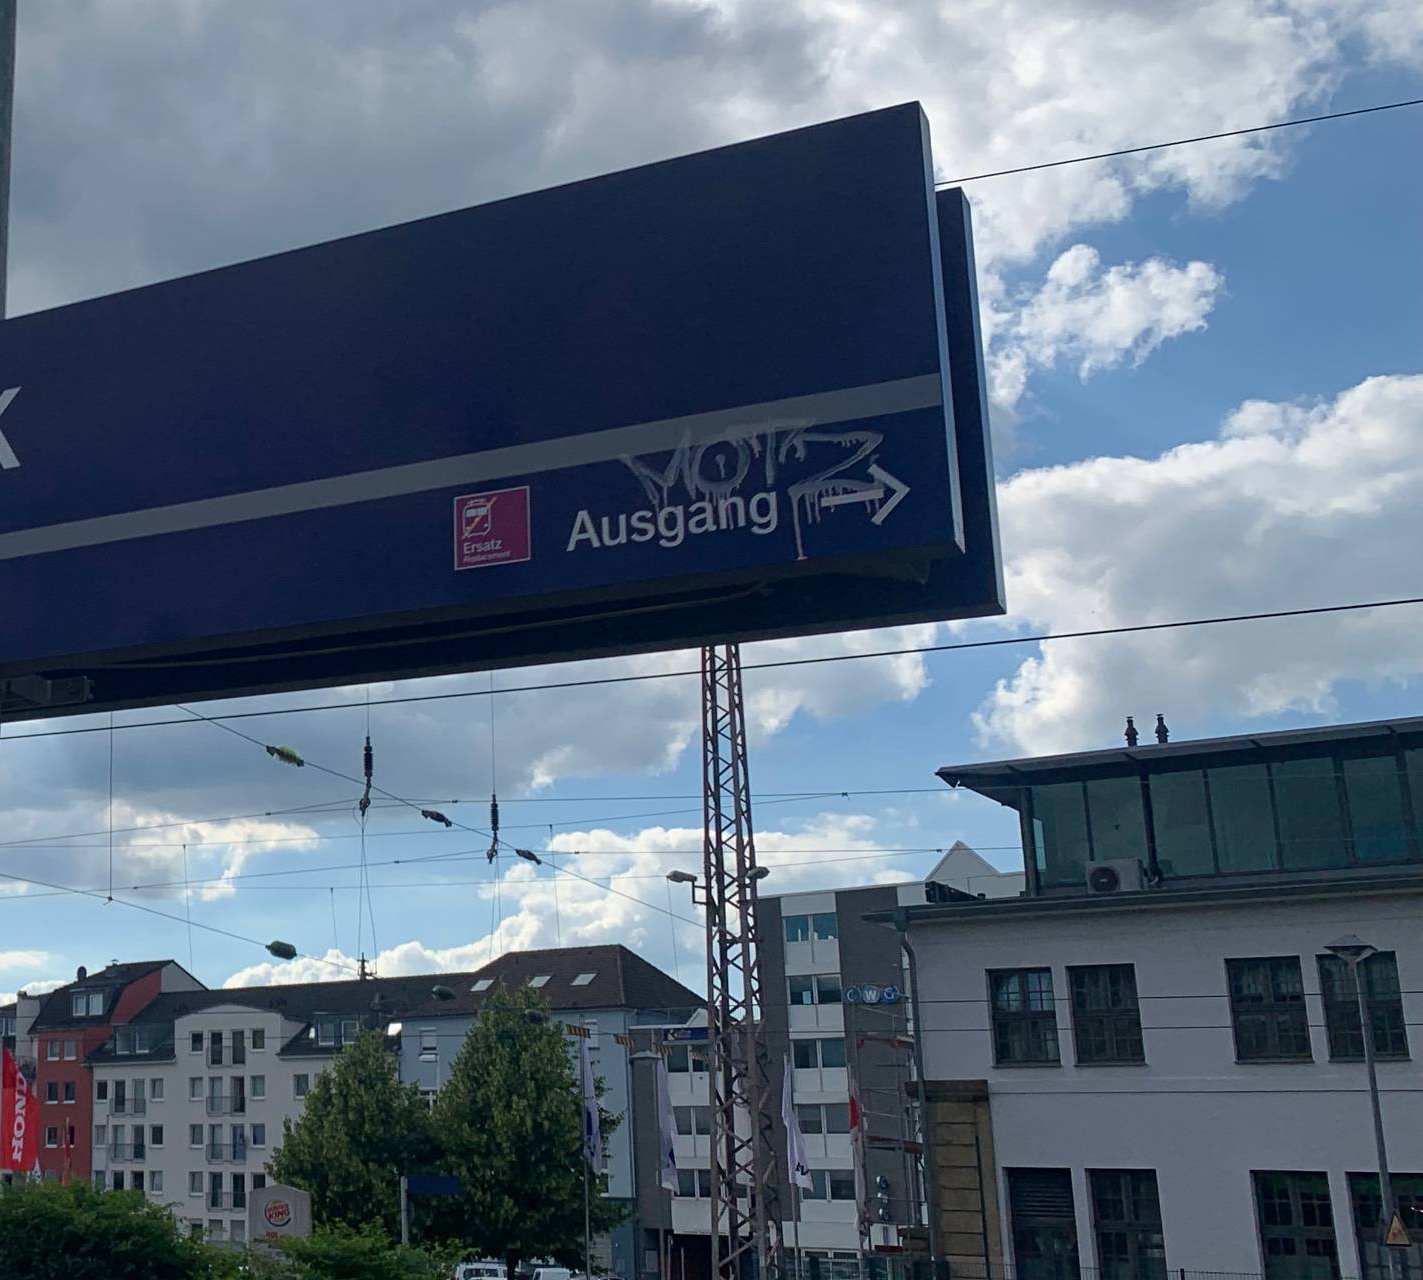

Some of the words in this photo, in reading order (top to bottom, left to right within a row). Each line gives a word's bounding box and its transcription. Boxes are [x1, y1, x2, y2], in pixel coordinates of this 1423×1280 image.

[463, 540, 503, 554] Ersatz
[565, 490, 778, 552] Ausgang
[11, 1060, 27, 1163] HOND
